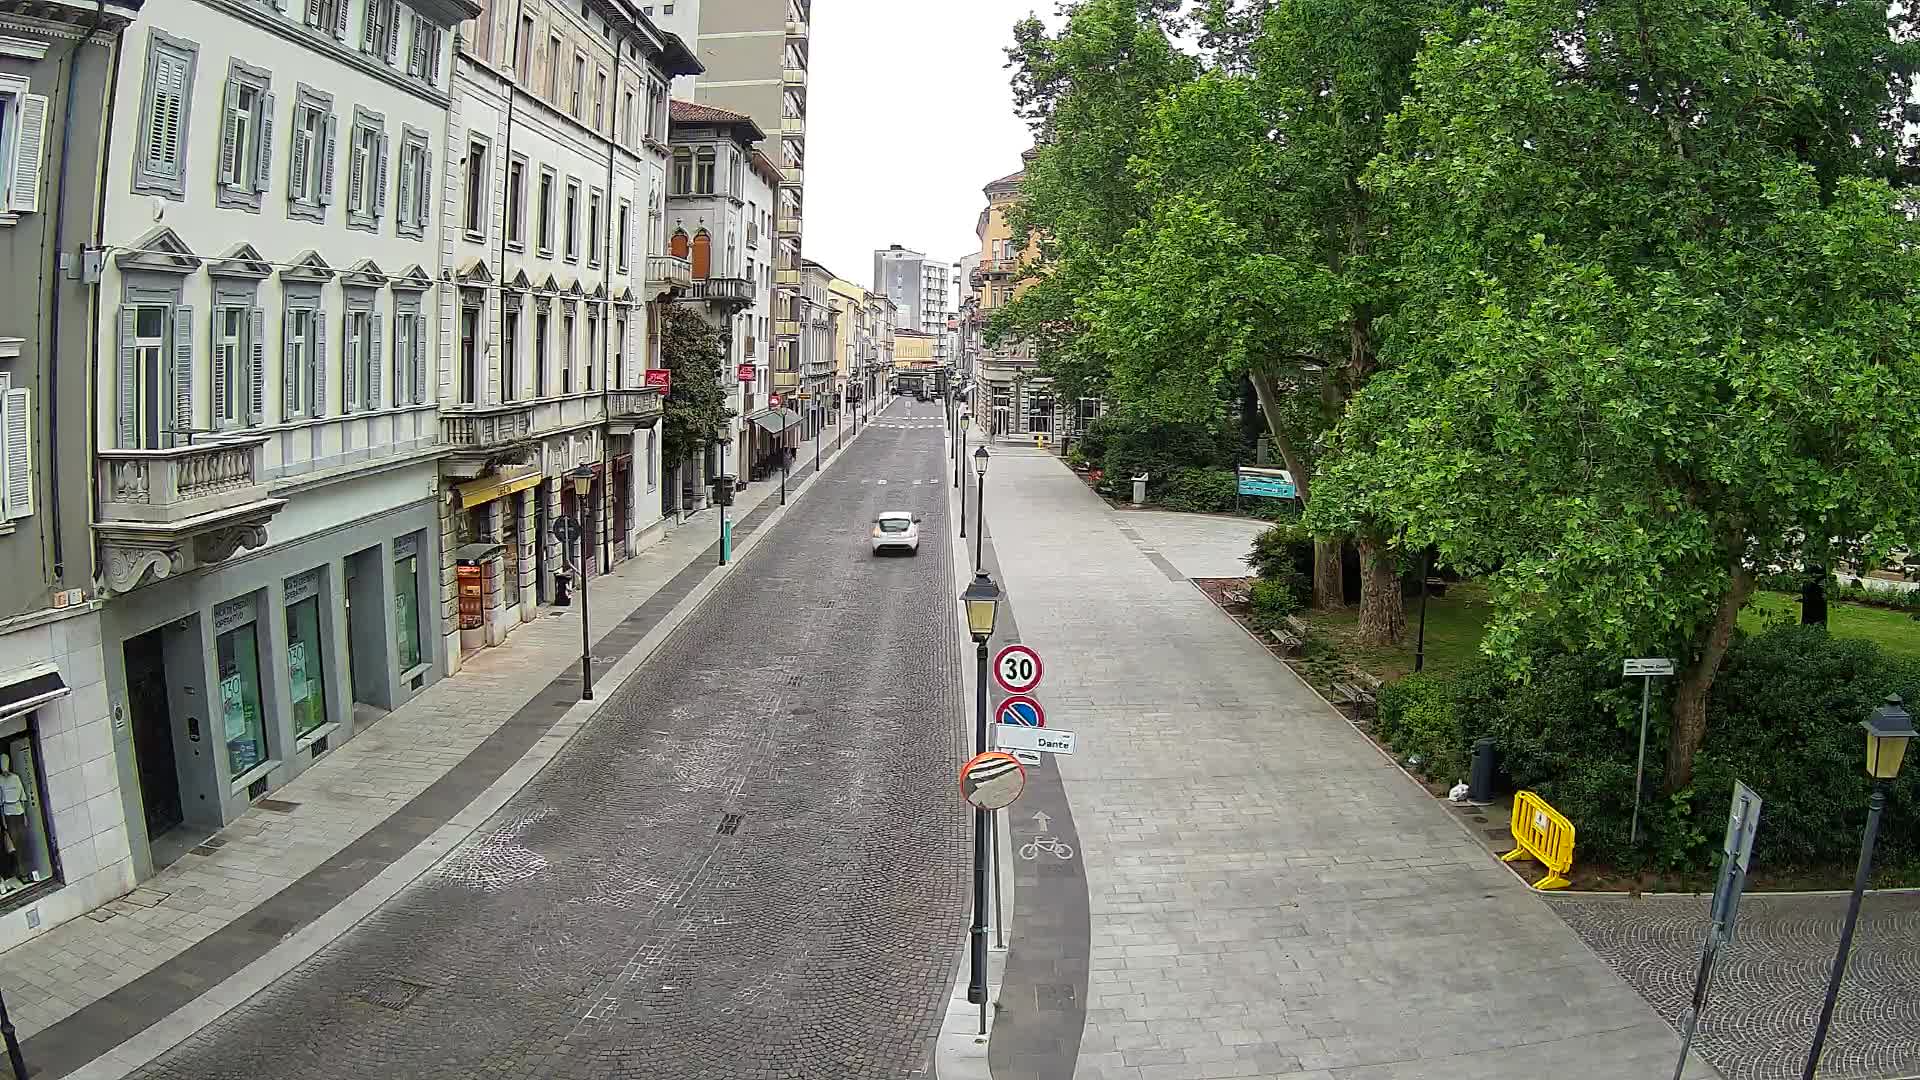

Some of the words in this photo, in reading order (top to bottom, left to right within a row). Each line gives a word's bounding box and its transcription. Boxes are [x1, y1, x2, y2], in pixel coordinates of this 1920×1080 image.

[287, 645, 303, 666] 130
[1005, 658, 1032, 680] 30
[222, 677, 240, 702] 130
[1038, 738, 1069, 749] Dante
